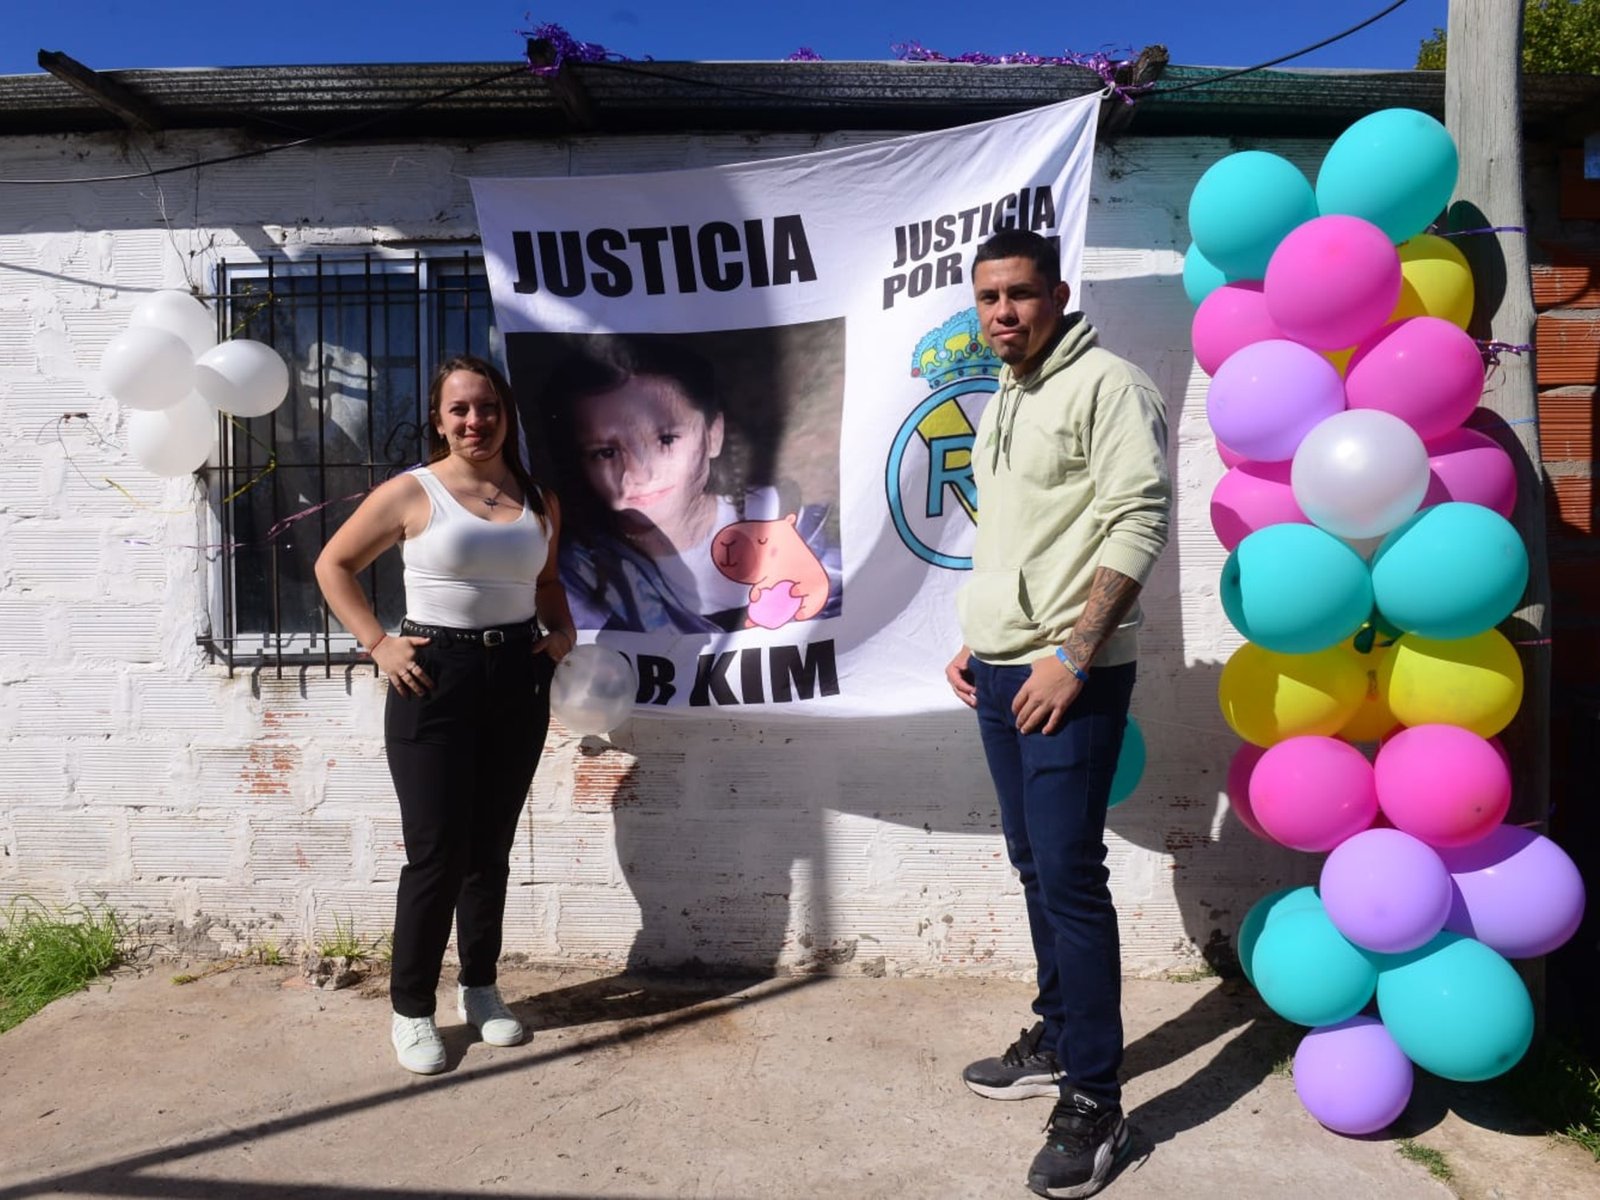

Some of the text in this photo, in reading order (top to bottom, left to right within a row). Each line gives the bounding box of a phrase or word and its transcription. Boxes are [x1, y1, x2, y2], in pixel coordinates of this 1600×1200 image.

[512, 214, 818, 298] JUSTICIA
[894, 185, 1056, 269] JUSTICIA
[882, 252, 963, 311] POR
[689, 639, 840, 707] KIM
